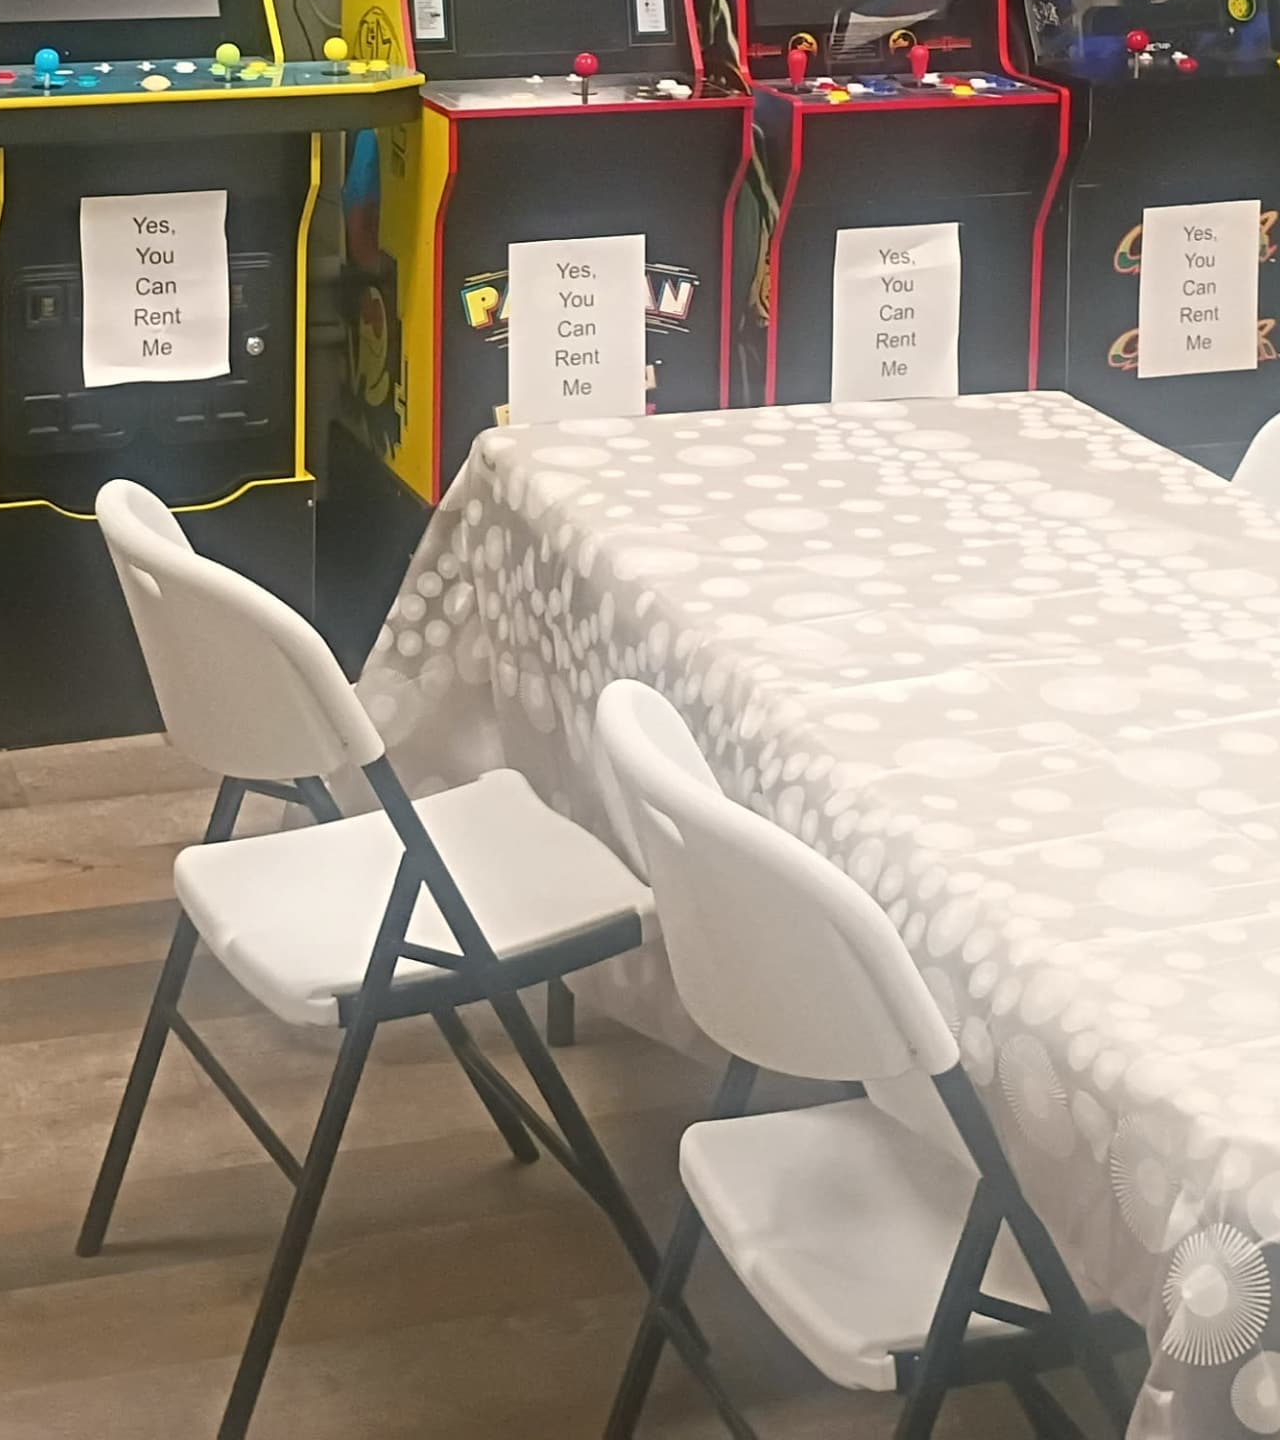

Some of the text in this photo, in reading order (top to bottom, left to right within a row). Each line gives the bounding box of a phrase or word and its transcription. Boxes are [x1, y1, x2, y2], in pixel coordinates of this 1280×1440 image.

[132, 216, 176, 235] Yes,
[1183, 225, 1218, 242] Yes,
[136, 247, 175, 265] You
[878, 248, 916, 266] Yes,
[1185, 252, 1216, 269] You
[556, 262, 597, 281] Yes,
[135, 277, 177, 296] Can
[881, 276, 914, 294] You
[1182, 279, 1217, 297] Can
[558, 290, 595, 309] You
[133, 308, 182, 327] Rent
[879, 304, 915, 322] Can
[1179, 306, 1220, 324] Rent
[557, 319, 597, 339] Can
[142, 339, 173, 357] Me
[875, 332, 917, 350] Rent
[1186, 334, 1212, 351] Me
[554, 348, 600, 368] Rent
[881, 360, 908, 377] Me
[562, 378, 593, 396] Me
